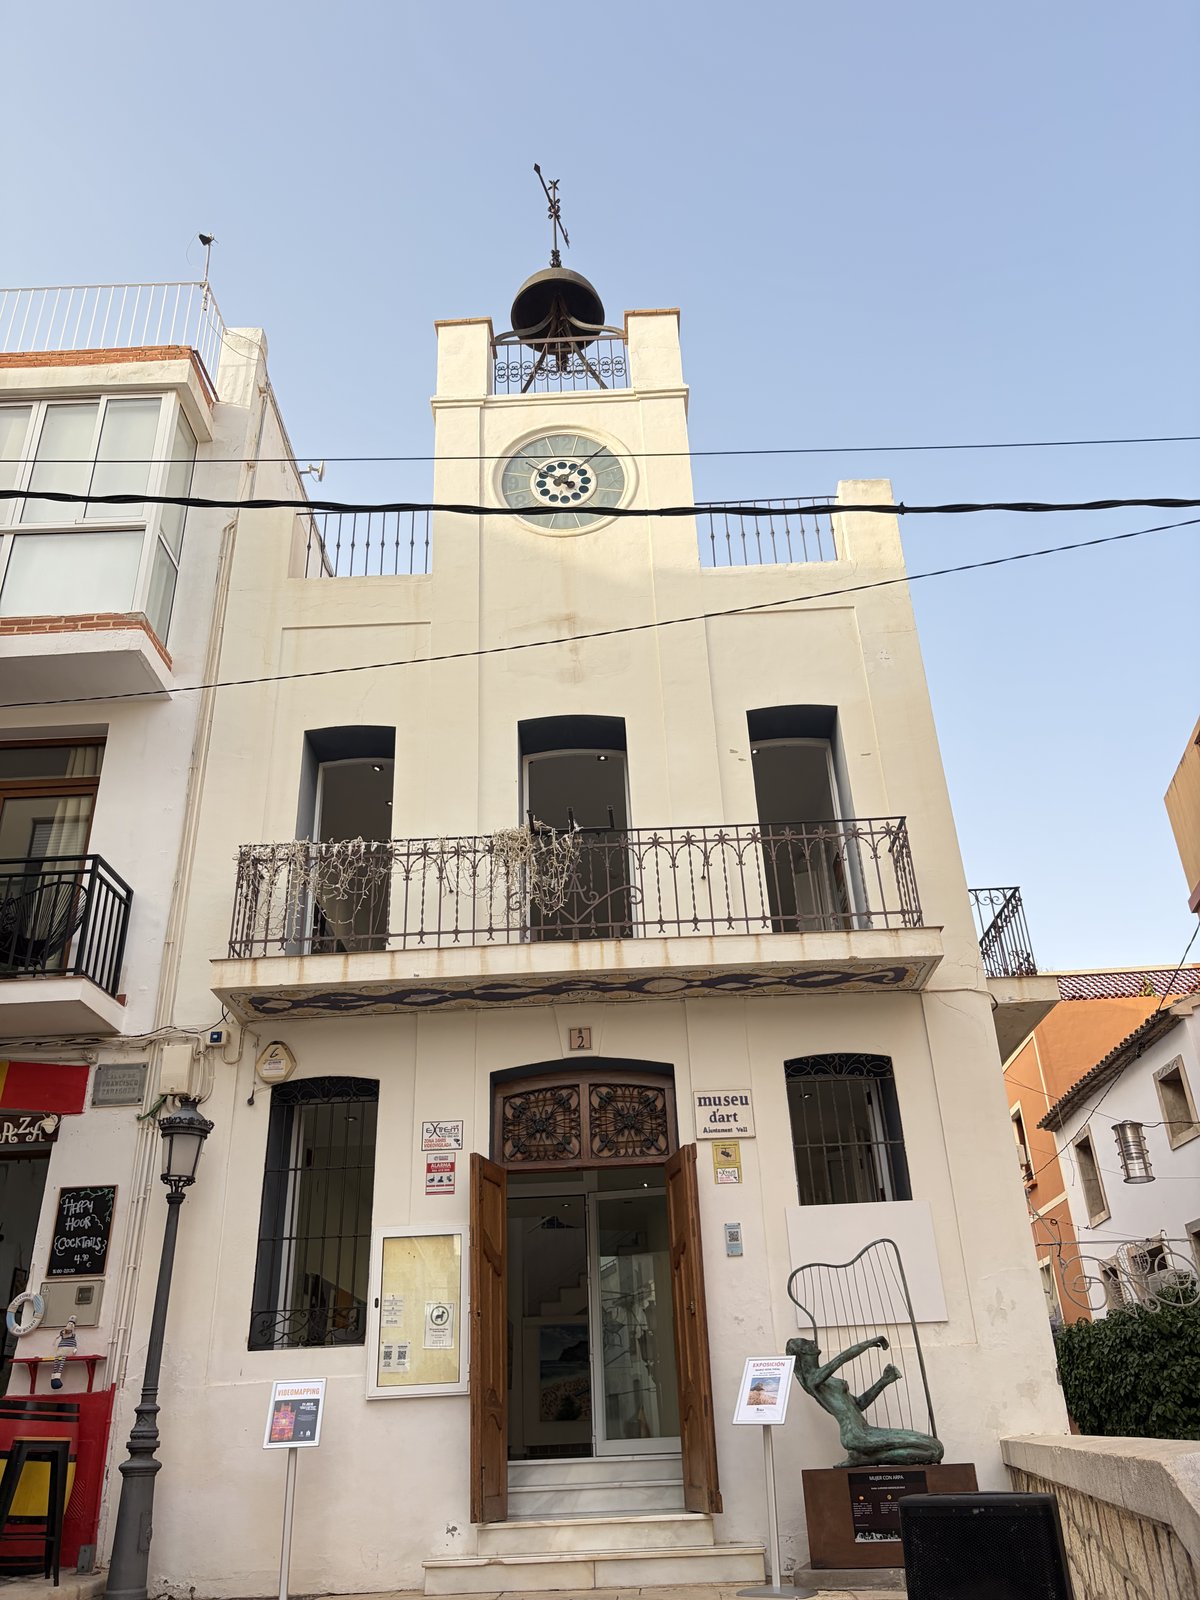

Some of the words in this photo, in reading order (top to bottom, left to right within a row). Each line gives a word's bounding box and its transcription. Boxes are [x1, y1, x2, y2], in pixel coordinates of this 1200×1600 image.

[577, 1035, 585, 1048] 2
[697, 1095, 749, 1107] museu
[709, 1108, 738, 1123] d'art
[63, 1199, 94, 1216] HAPPY
[65, 1216, 91, 1231] HOUR
[278, 1388, 320, 1397] VIDEOMAPPING
